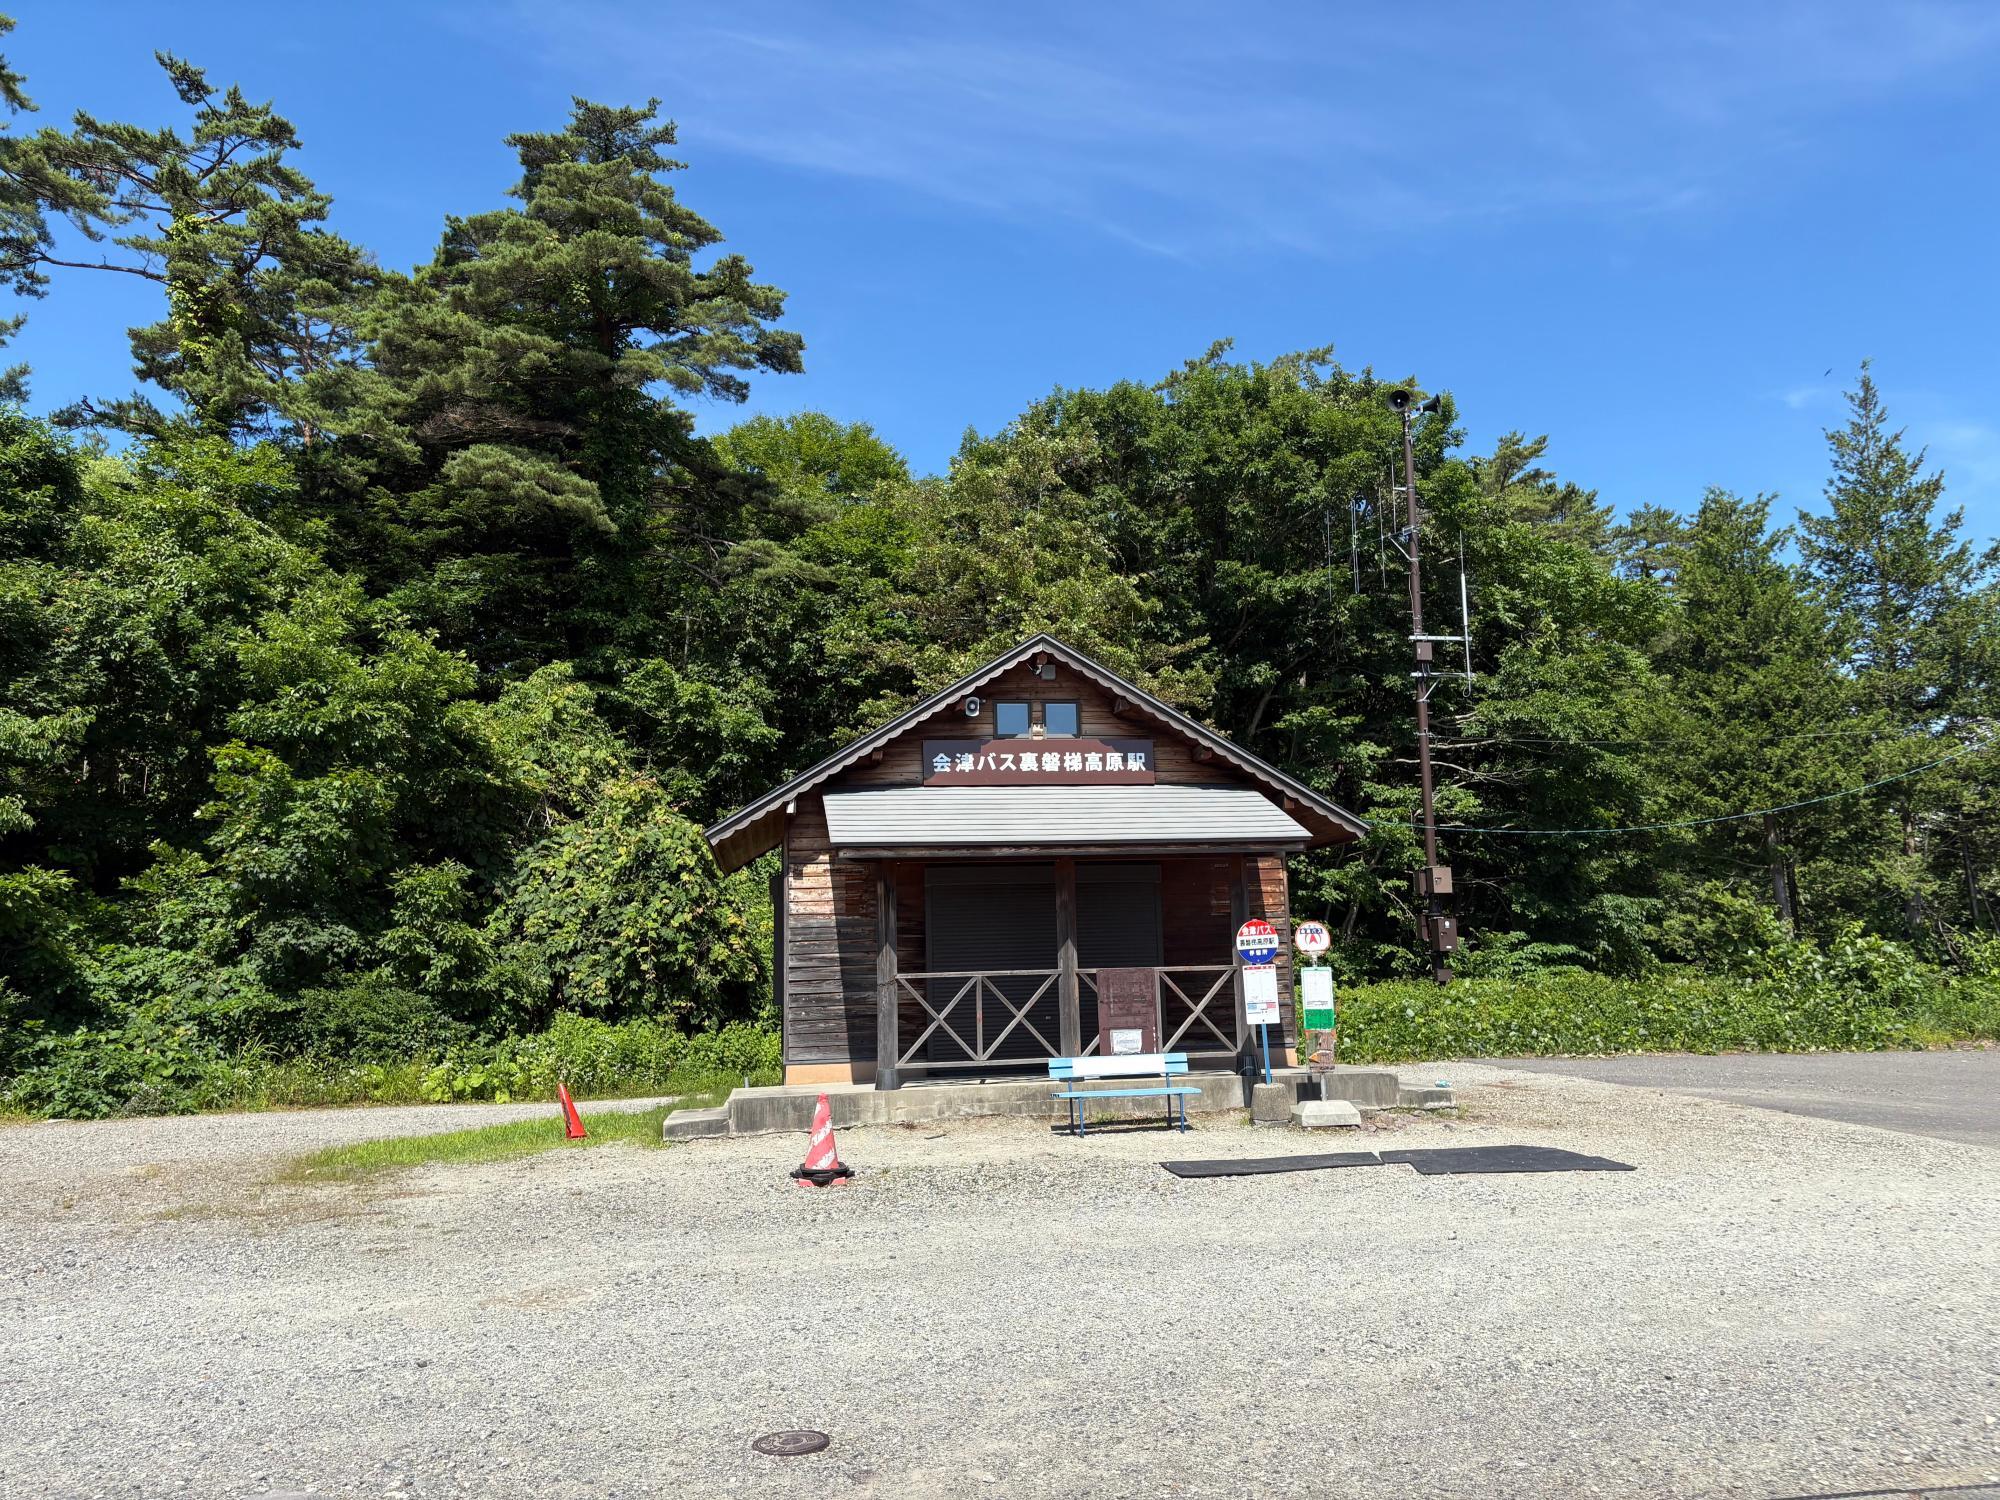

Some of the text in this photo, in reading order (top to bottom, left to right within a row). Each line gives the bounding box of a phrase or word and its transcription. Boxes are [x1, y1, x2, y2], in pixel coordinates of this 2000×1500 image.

[932, 752, 1147, 773] 会津バス裏磐梯高原駅
